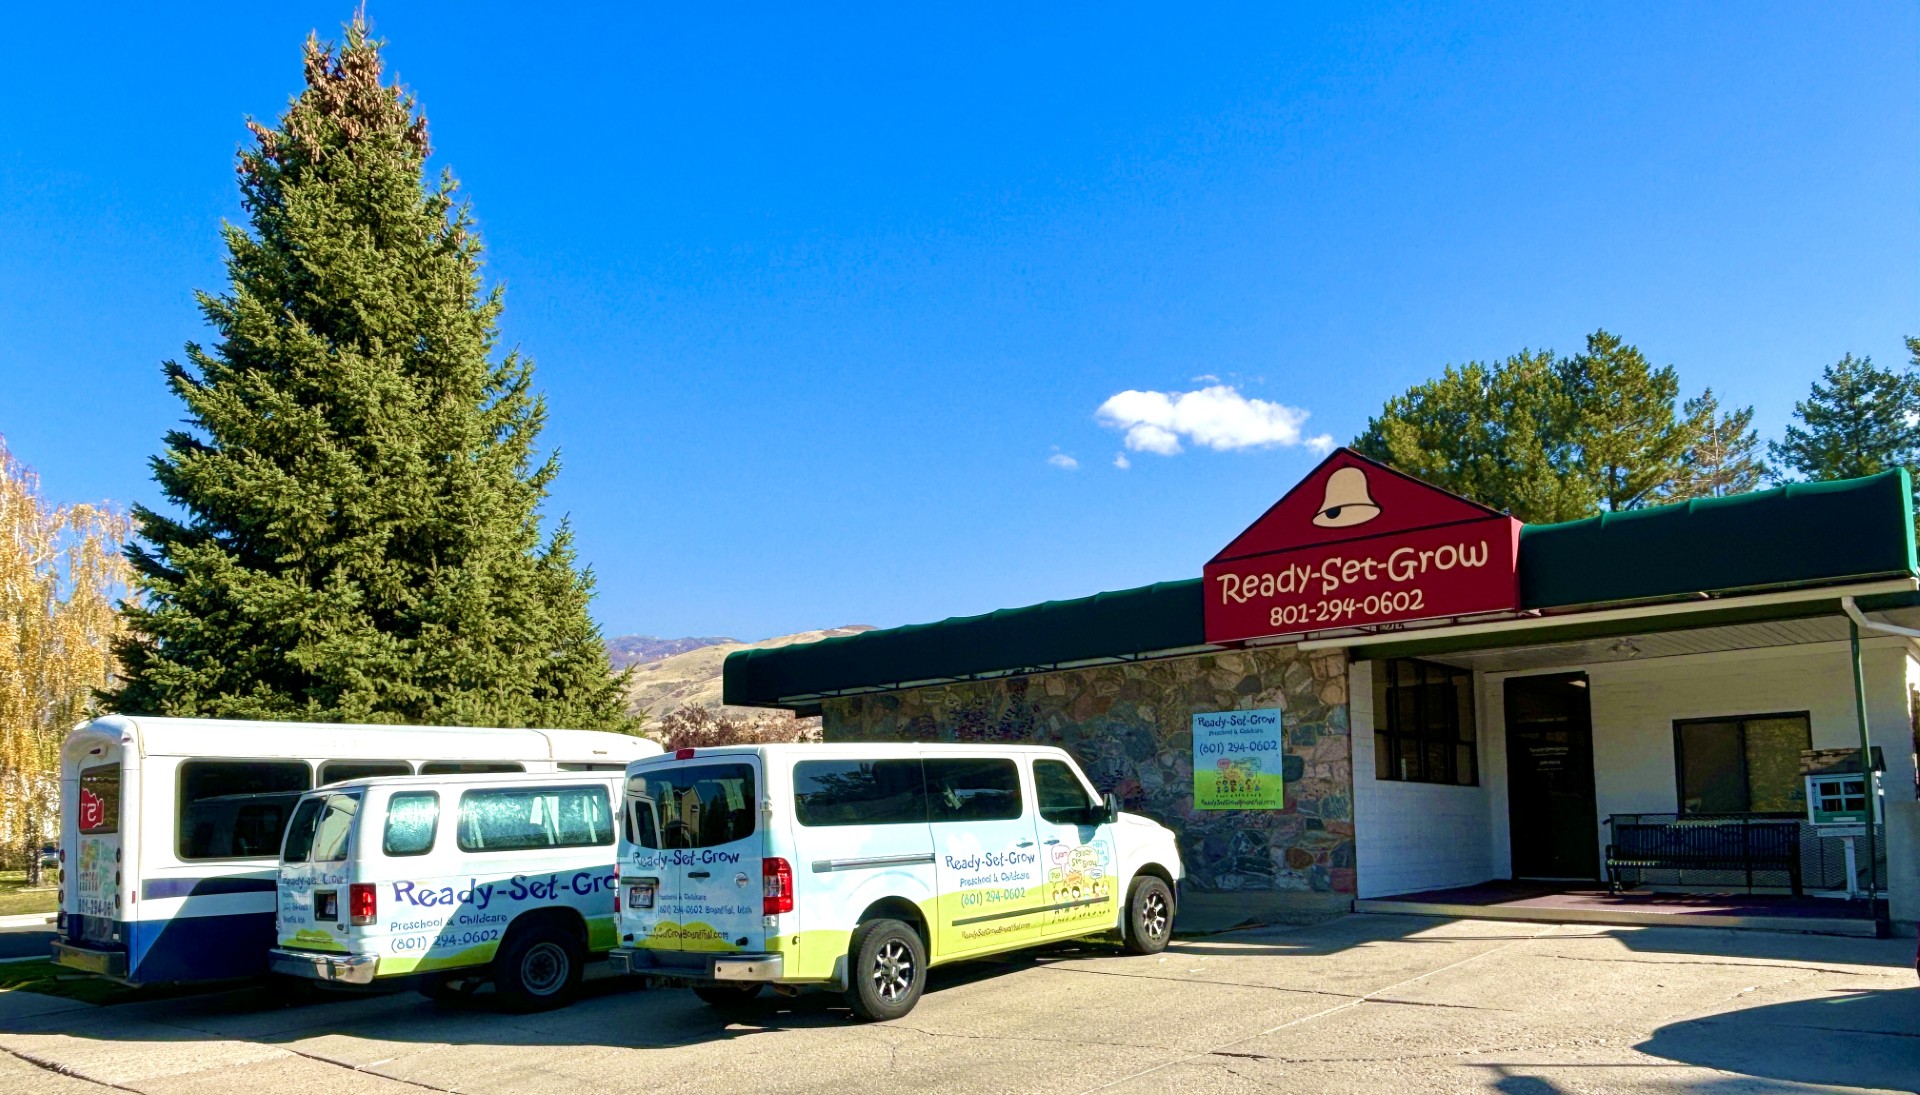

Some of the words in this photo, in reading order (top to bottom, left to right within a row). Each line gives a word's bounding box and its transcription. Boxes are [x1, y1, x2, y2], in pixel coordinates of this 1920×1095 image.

[1216, 540, 1488, 605] Ready-Set-Grow
[1269, 588, 1425, 627] 801-294-0602
[1197, 714, 1276, 729] Ready-Set-Grow
[1199, 741, 1225, 756] (801)
[1227, 740, 1278, 753] 294-0602
[632, 849, 740, 871] Ready-Set-Grow
[945, 851, 1036, 873] Ready-Set-Grow
[961, 890, 983, 909] (801)
[985, 886, 1026, 903] 294-0602
[389, 917, 443, 932] Preschool
[459, 913, 508, 926] Childcare
[391, 935, 427, 953] (801)
[433, 929, 499, 948] 294-0602
